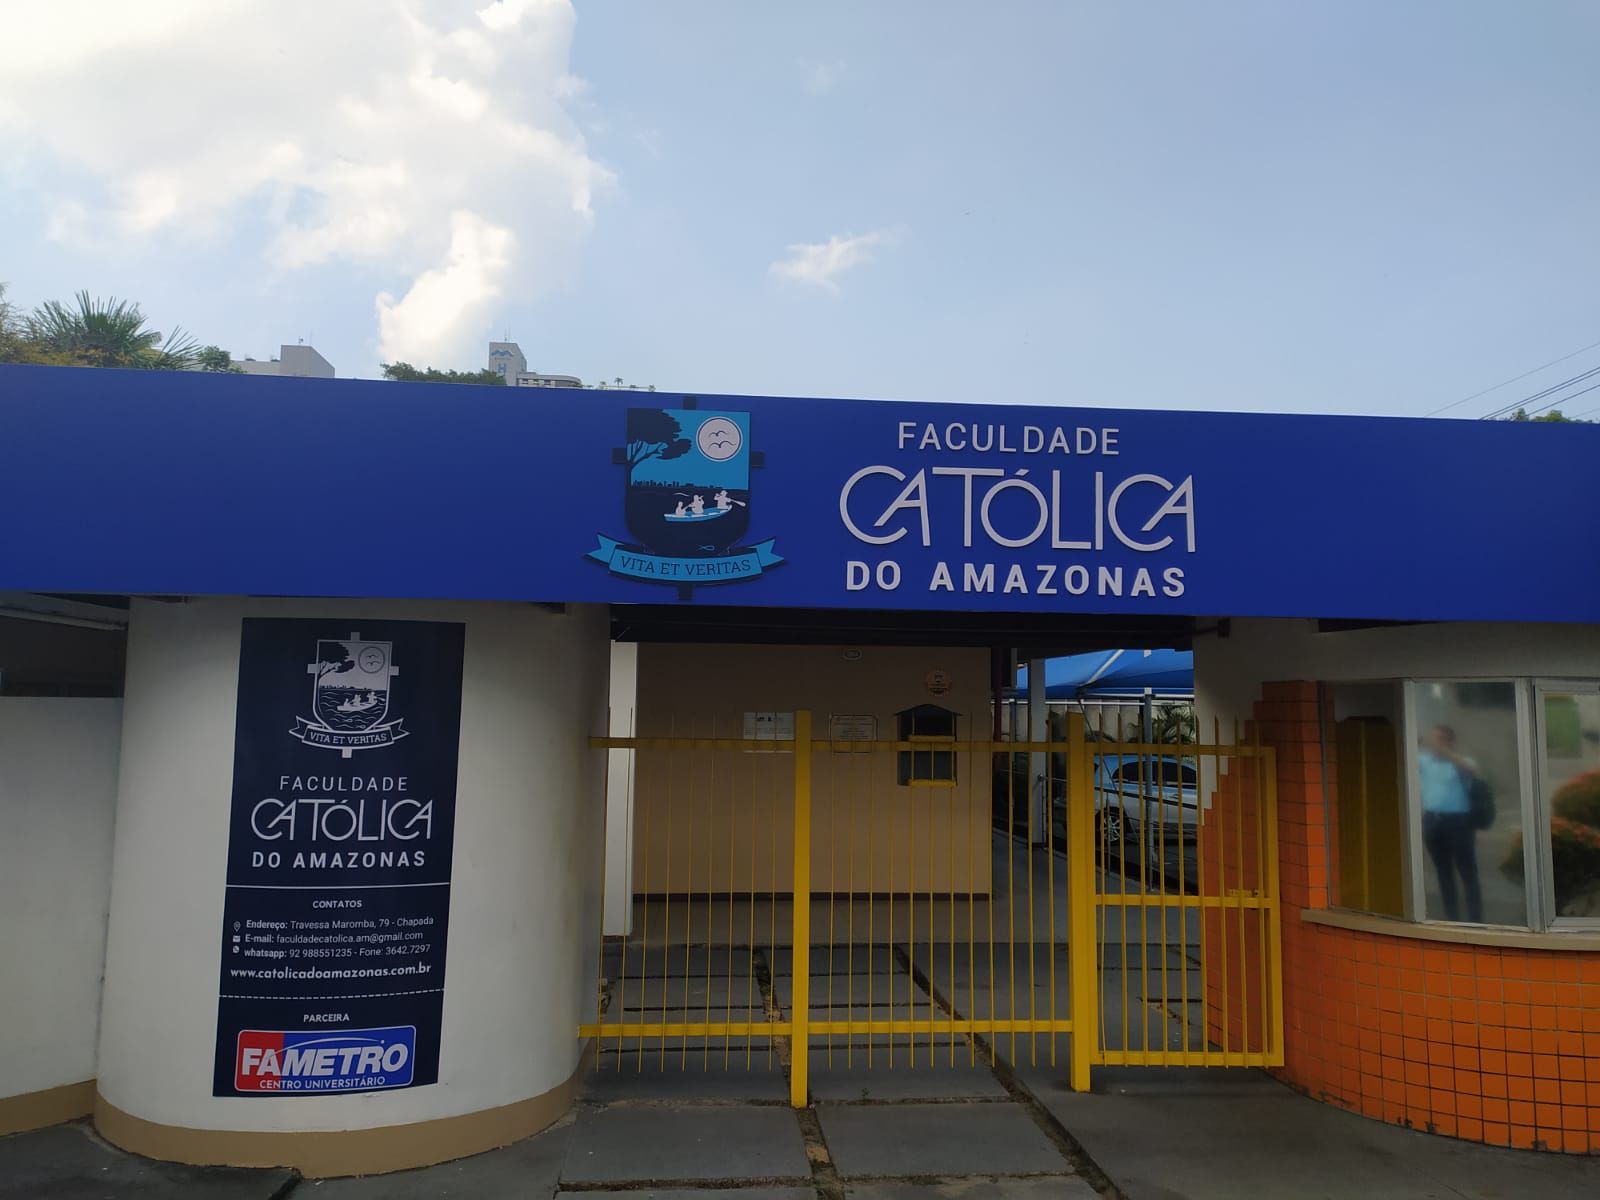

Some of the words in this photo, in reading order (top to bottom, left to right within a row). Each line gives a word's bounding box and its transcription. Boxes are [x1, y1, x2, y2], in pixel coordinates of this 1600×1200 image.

[898, 421, 1120, 455] FACULDADE
[839, 465, 1196, 553] CATÓLICA
[621, 555, 655, 573] VITA
[660, 563, 680, 575] ET
[685, 559, 751, 576] VERITAS
[846, 560, 901, 592] DO
[930, 561, 1187, 597] AMAZONAS
[310, 731, 331, 744] VITA
[333, 735, 345, 744] ET
[347, 733, 388, 745] VERITAS
[279, 775, 409, 792] FACULDADE
[251, 798, 433, 841] CATÓLICA
[252, 851, 281, 868] DO
[293, 850, 426, 869] AMAZONAS
[312, 900, 363, 909] CONTATOS
[246, 919, 288, 932] Endereço:
[290, 920, 330, 929] Travessa
[332, 919, 377, 929] Maromba,
[379, 918, 390, 928] 79
[397, 916, 434, 928] Chapada
[245, 933, 275, 943] E-mail:
[277, 931, 424, 944] faculdadecatolica.am@gmail.com
[244, 947, 287, 960] whatsapp:
[289, 948, 300, 958] 92
[302, 948, 353, 958] 988551235
[360, 947, 384, 957] Fone:
[386, 944, 431, 956] 3642.7297
[230, 961, 432, 979] www.catolicadoamazonas.com.br
[303, 1013, 350, 1023] PARCEIRA
[241, 1043, 409, 1077] FAMETRO
[259, 1079, 301, 1089] CENTRO
[305, 1075, 386, 1089] UNIVERSITÁRIO
